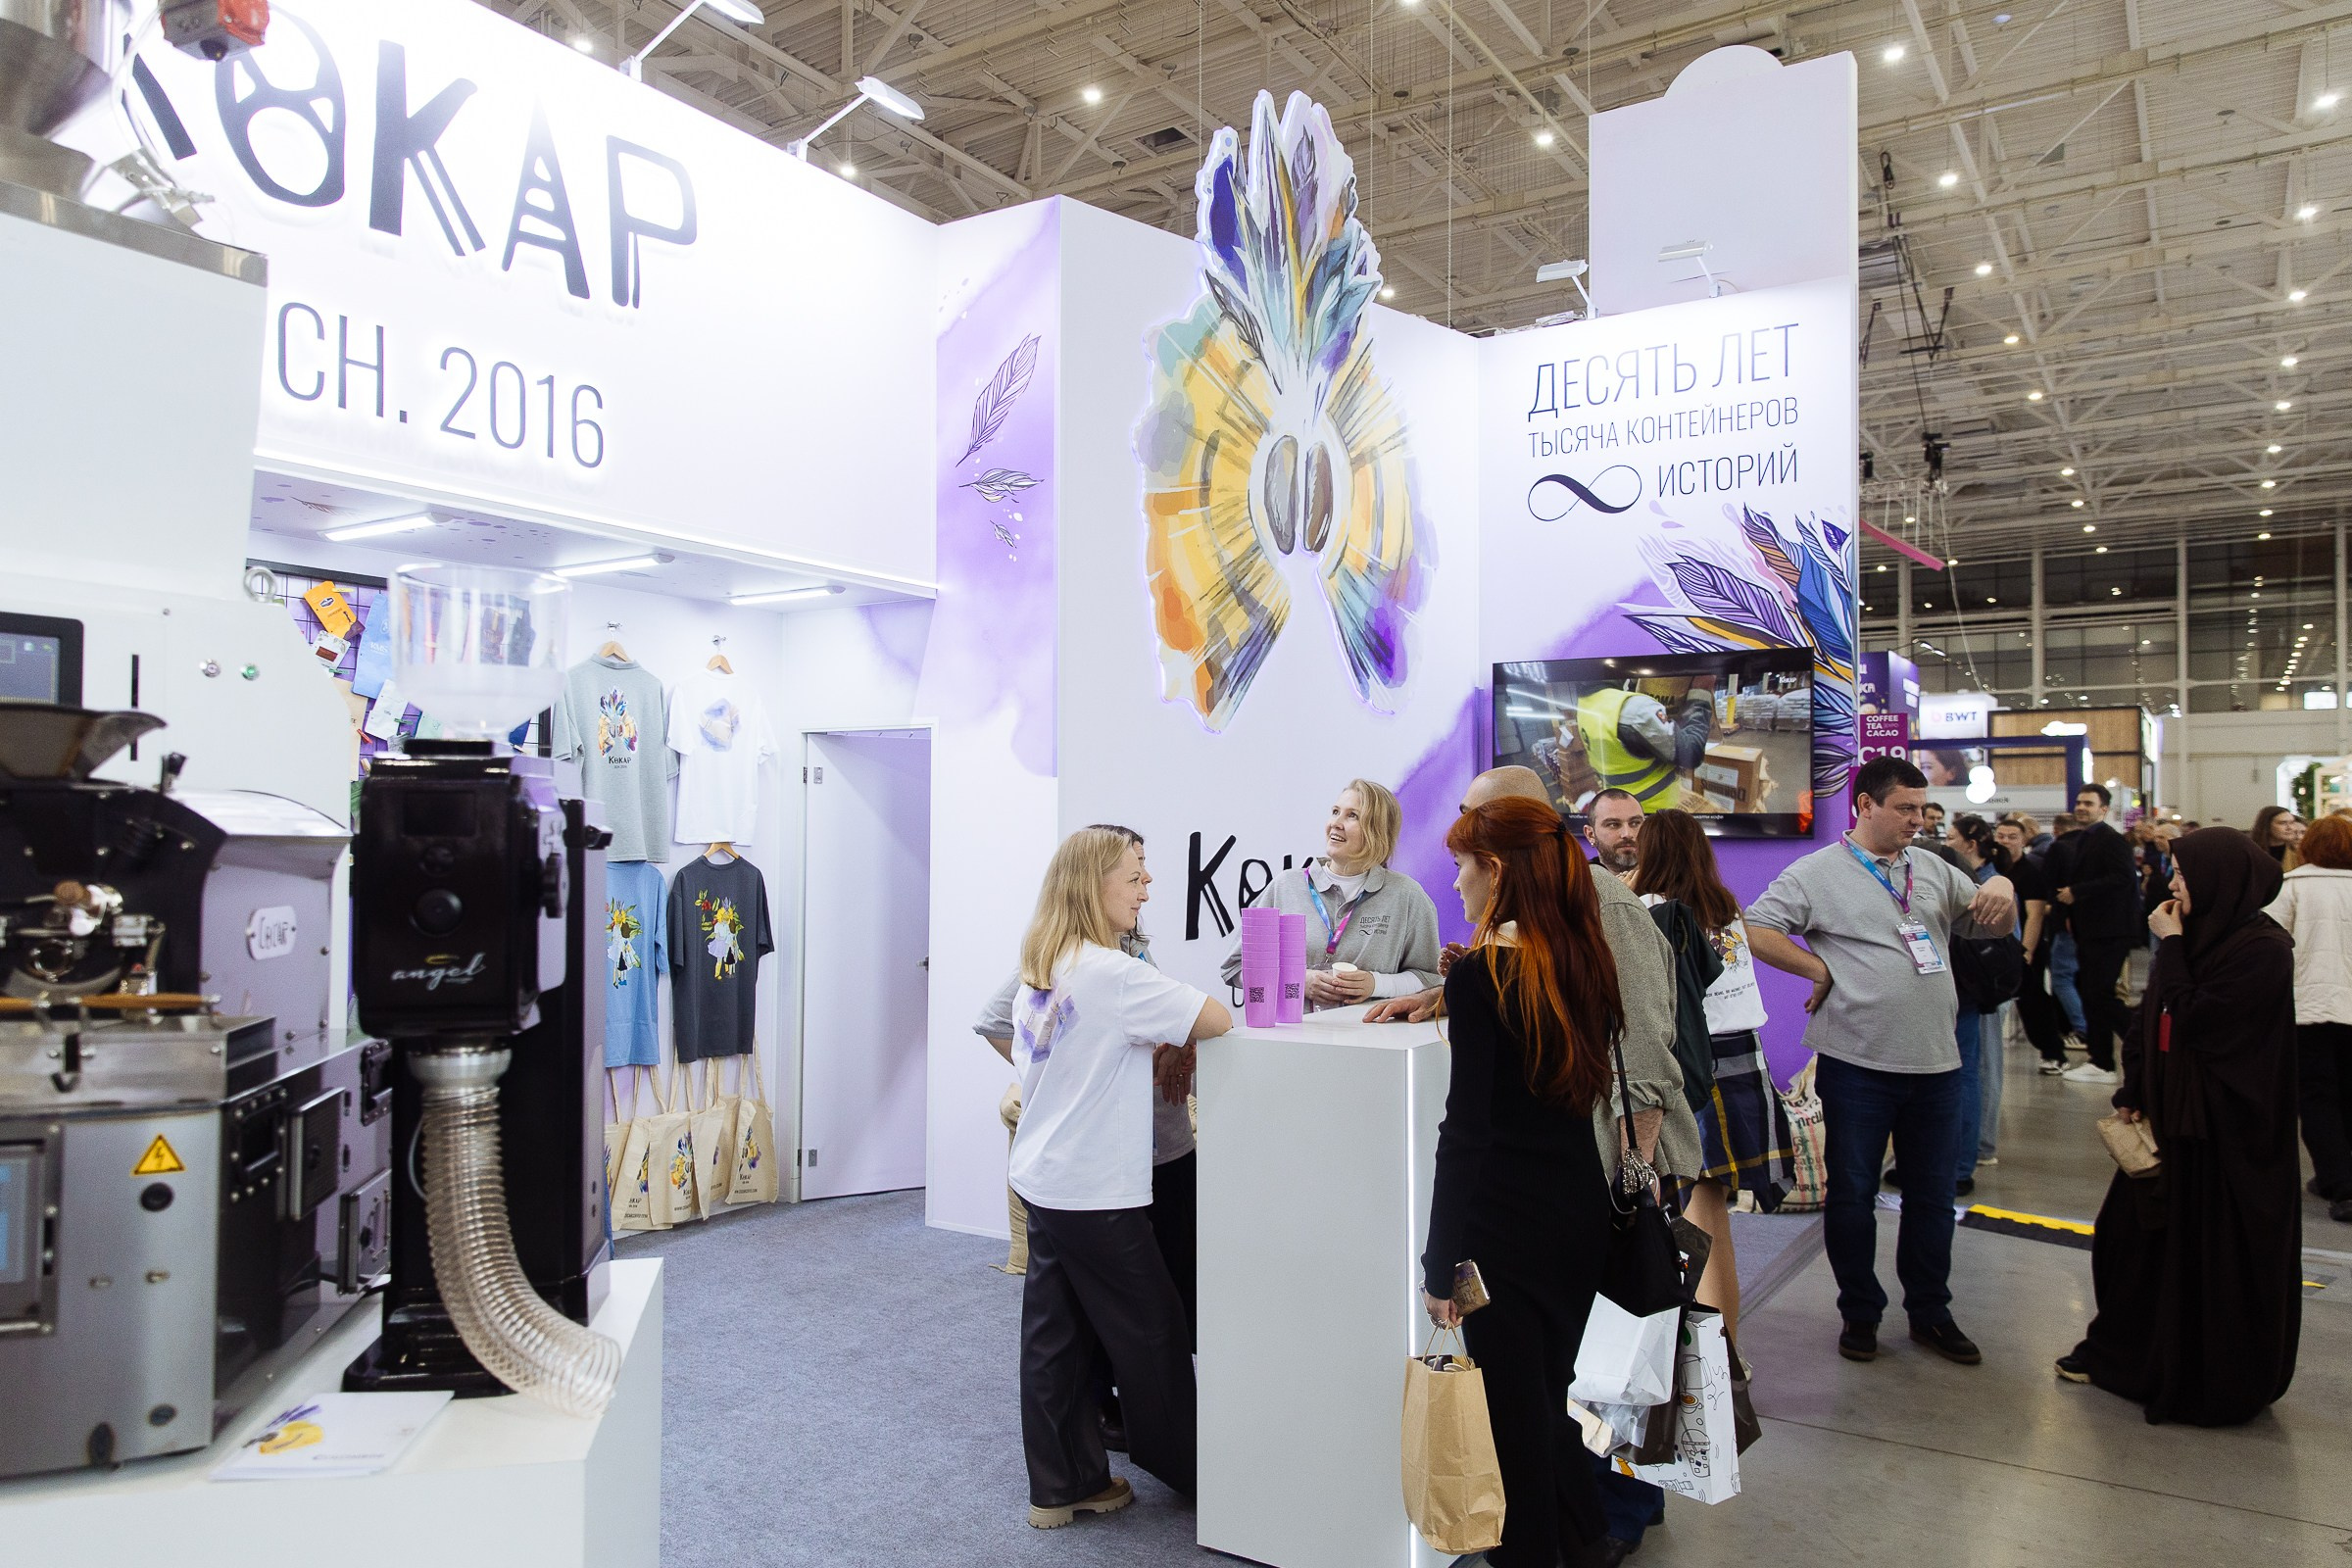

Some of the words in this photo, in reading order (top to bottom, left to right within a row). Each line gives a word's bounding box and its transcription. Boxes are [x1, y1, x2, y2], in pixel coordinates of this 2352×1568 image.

[1528, 343, 1697, 422] ДЕСЯТЬ
[1711, 322, 1799, 388] ЛЕТ
[438, 345, 605, 469] 2016
[1528, 421, 1619, 458] ТЫСЯЧА
[1627, 396, 1799, 446] КОНТЕЙНЕРОВ
[1658, 442, 1798, 498] ИСТОРИЙ
[1945, 711, 1978, 722] BWT
[391, 952, 486, 991] angel
